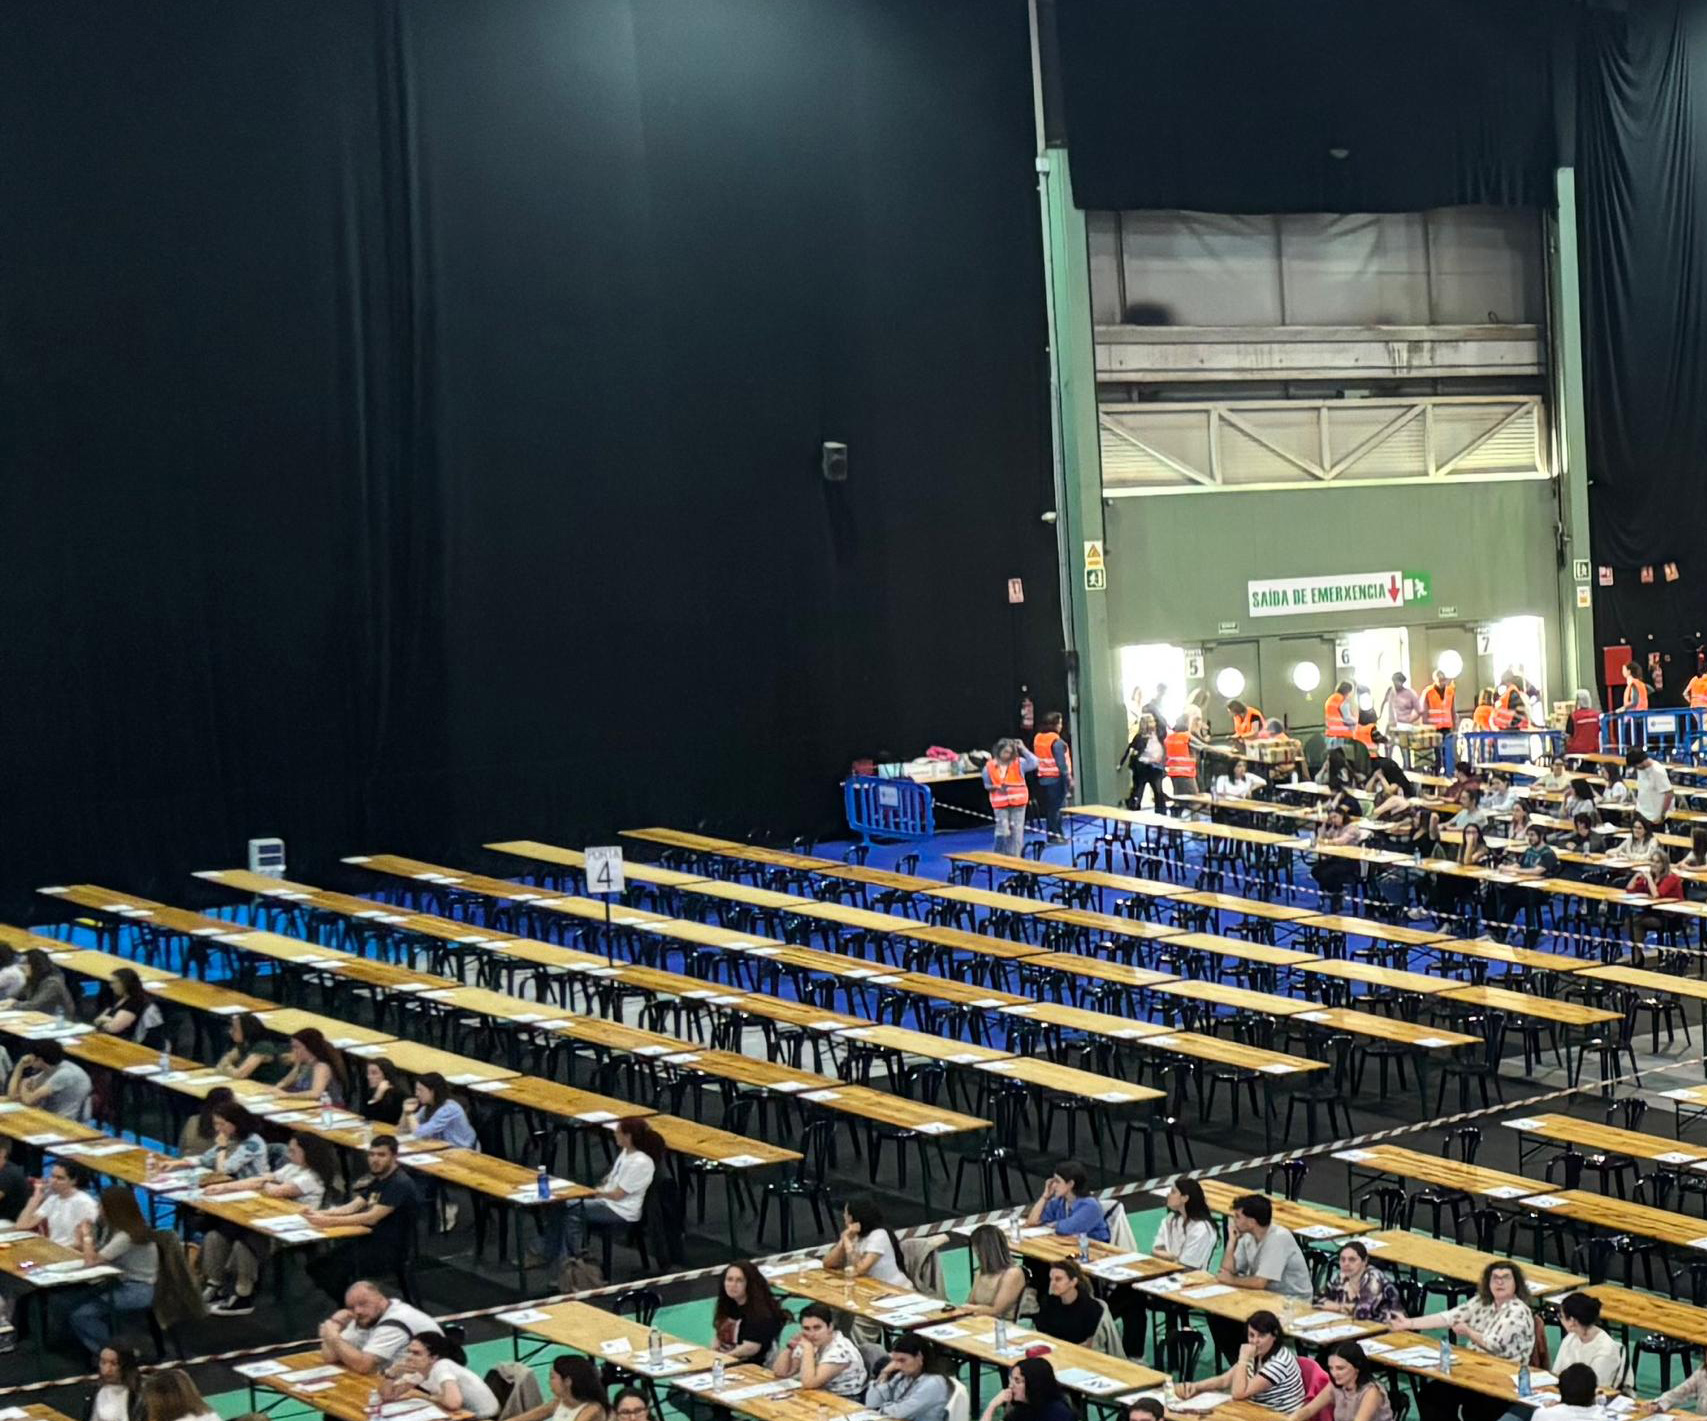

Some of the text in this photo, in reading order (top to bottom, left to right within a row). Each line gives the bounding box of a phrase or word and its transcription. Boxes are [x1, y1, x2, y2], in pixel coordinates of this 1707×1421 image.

[1252, 582, 1387, 608] SAÍDA DE EMERXENCIA
[1482, 636, 1490, 652] 7
[1342, 649, 1350, 664] 6
[1189, 659, 1198, 675] 5
[597, 861, 613, 886] 4
